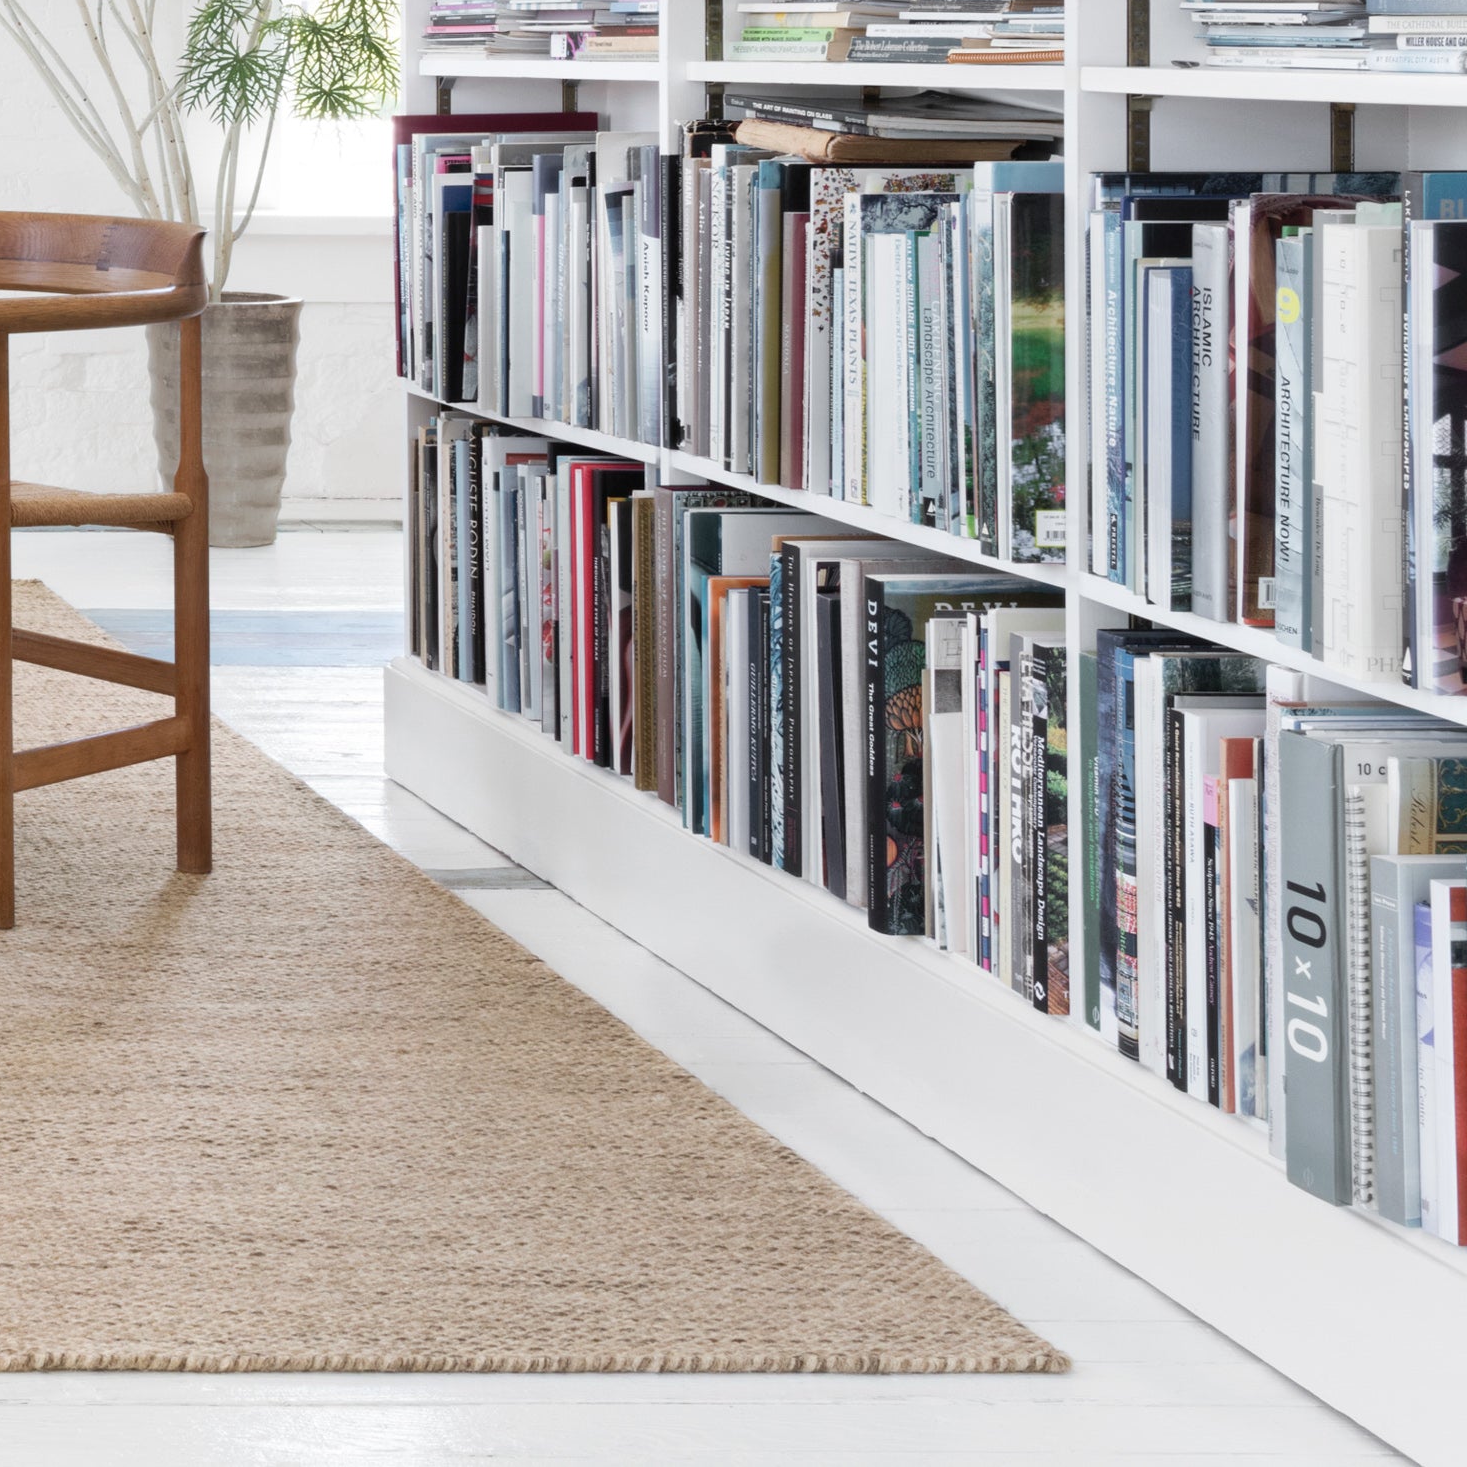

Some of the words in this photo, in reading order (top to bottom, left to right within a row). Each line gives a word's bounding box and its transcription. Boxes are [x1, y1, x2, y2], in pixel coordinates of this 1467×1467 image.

[1405, 37, 1424, 47] MILLER
[1425, 37, 1444, 47] HOUSE
[1445, 37, 1458, 47] AND
[752, 101, 763, 110] THE
[764, 103, 774, 111] ART
[774, 105, 782, 113] OF
[782, 106, 806, 117] PAINTING
[807, 110, 815, 118] ON
[816, 111, 833, 121] GLASS
[642, 242, 650, 280] Anish
[849, 220, 857, 273] NATIVE
[642, 284, 650, 334] Kapoor
[849, 278, 858, 323] TEXAS
[1202, 287, 1212, 367] ISLAMIC
[1276, 286, 1301, 323] 9
[849, 329, 858, 384] PLANTS
[923, 307, 934, 385] Landscape
[1192, 285, 1200, 442] ARCHITECTURE
[926, 389, 937, 479] Architecture
[1280, 374, 1290, 509] ARCHITECTURE
[467, 433, 477, 512] AUGUSTE
[468, 519, 478, 579] RODIN
[1280, 513, 1290, 563] NOW!
[866, 599, 878, 668] DEVI
[868, 682, 876, 702] The
[868, 704, 876, 731] Great
[868, 733, 876, 777] Goddess
[1036, 736, 1045, 827] Mediterranean
[1357, 763, 1371, 776] 10
[1036, 831, 1045, 896] Landscape
[1206, 857, 1215, 898] Sculpture
[1036, 899, 1046, 940] Design
[1286, 880, 1327, 949] 10
[1287, 991, 1328, 1063] 10
